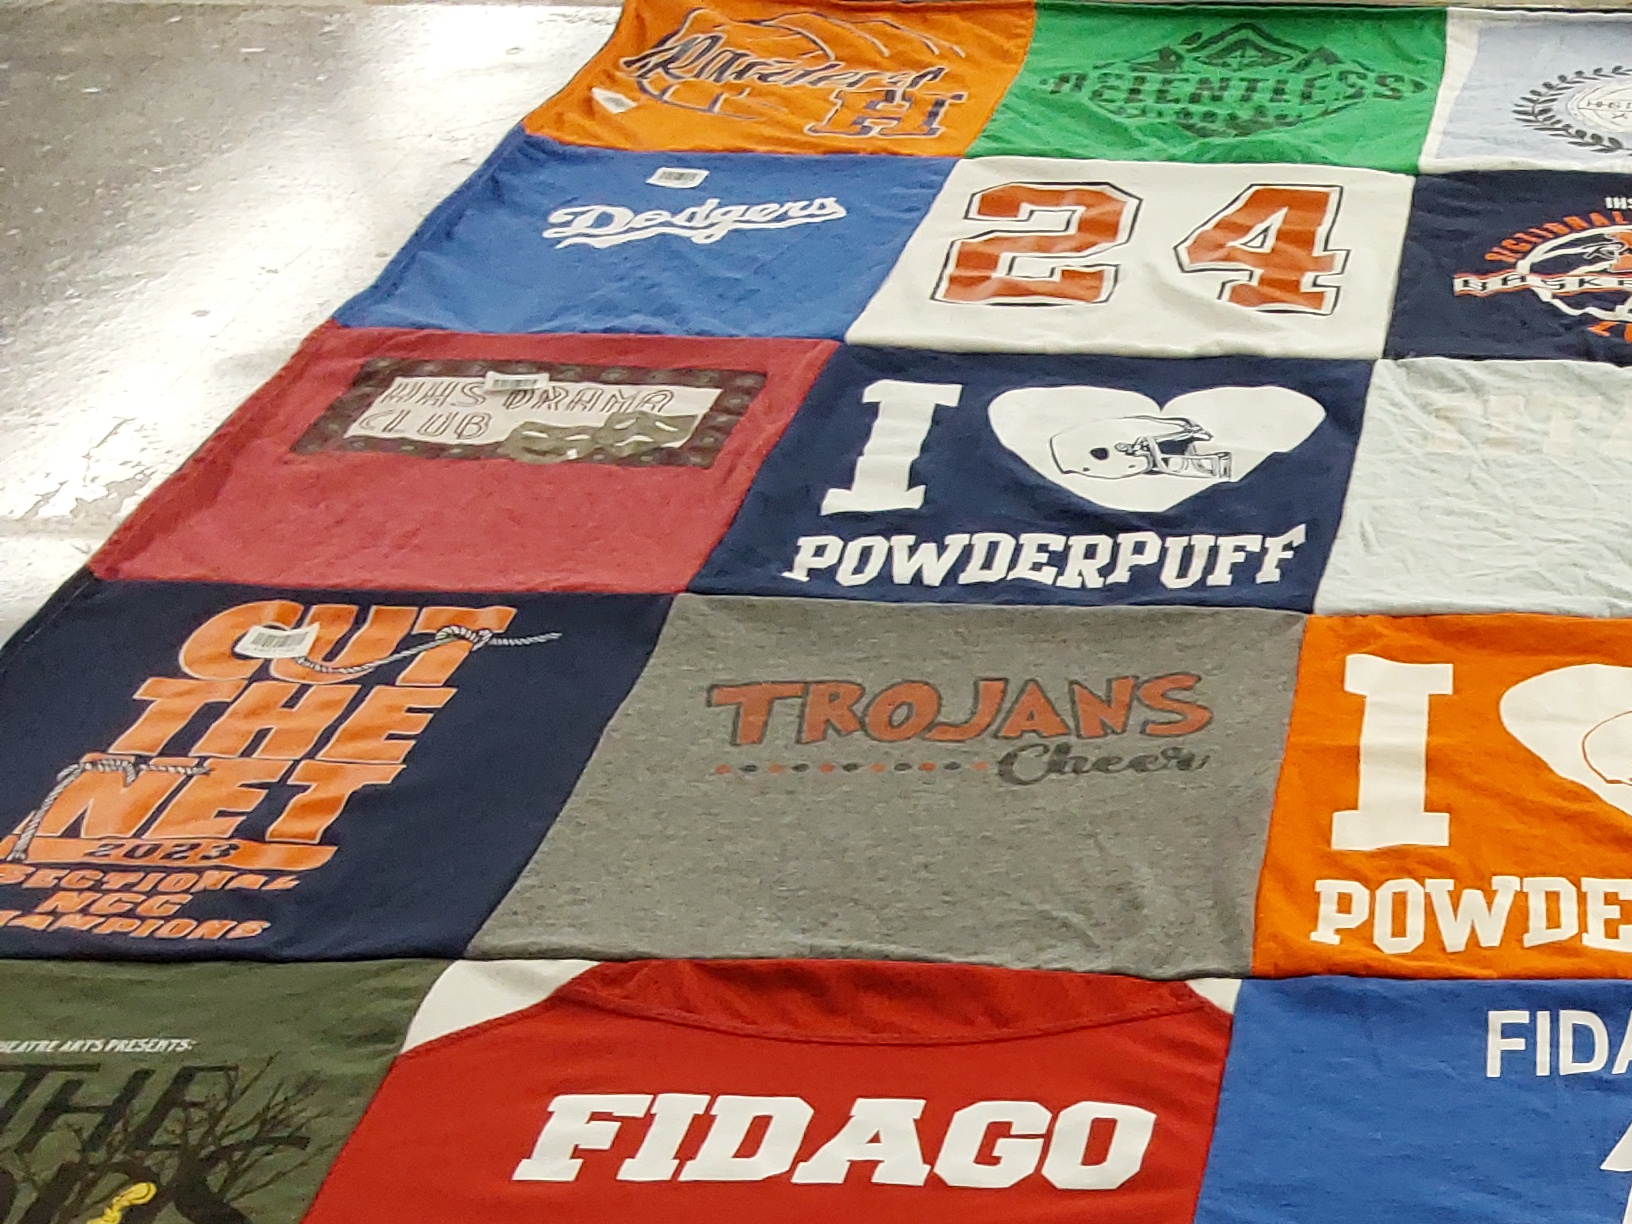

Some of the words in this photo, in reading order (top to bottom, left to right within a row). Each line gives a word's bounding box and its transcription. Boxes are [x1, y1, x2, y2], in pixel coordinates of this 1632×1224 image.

[620, 33, 946, 93] Raiders
[1048, 70, 1414, 103] RELENTLESS
[542, 196, 847, 248] Dodgers
[930, 181, 1351, 316] 24
[360, 409, 493, 440] CLUB
[502, 385, 676, 413] DRAMA
[819, 378, 963, 516] I
[781, 524, 1306, 590] POWDERPUFF
[178, 599, 517, 685] CUT
[108, 676, 459, 765] THE
[706, 671, 1214, 746] TROJANS
[997, 742, 1212, 786] Cheer
[1331, 654, 1453, 851] I
[12, 752, 407, 844] NET
[0, 863, 301, 893] SECTIONAL
[87, 843, 241, 861] 2023
[0, 910, 272, 940] AMPIONS
[511, 1092, 1157, 1191] FIDAGO
